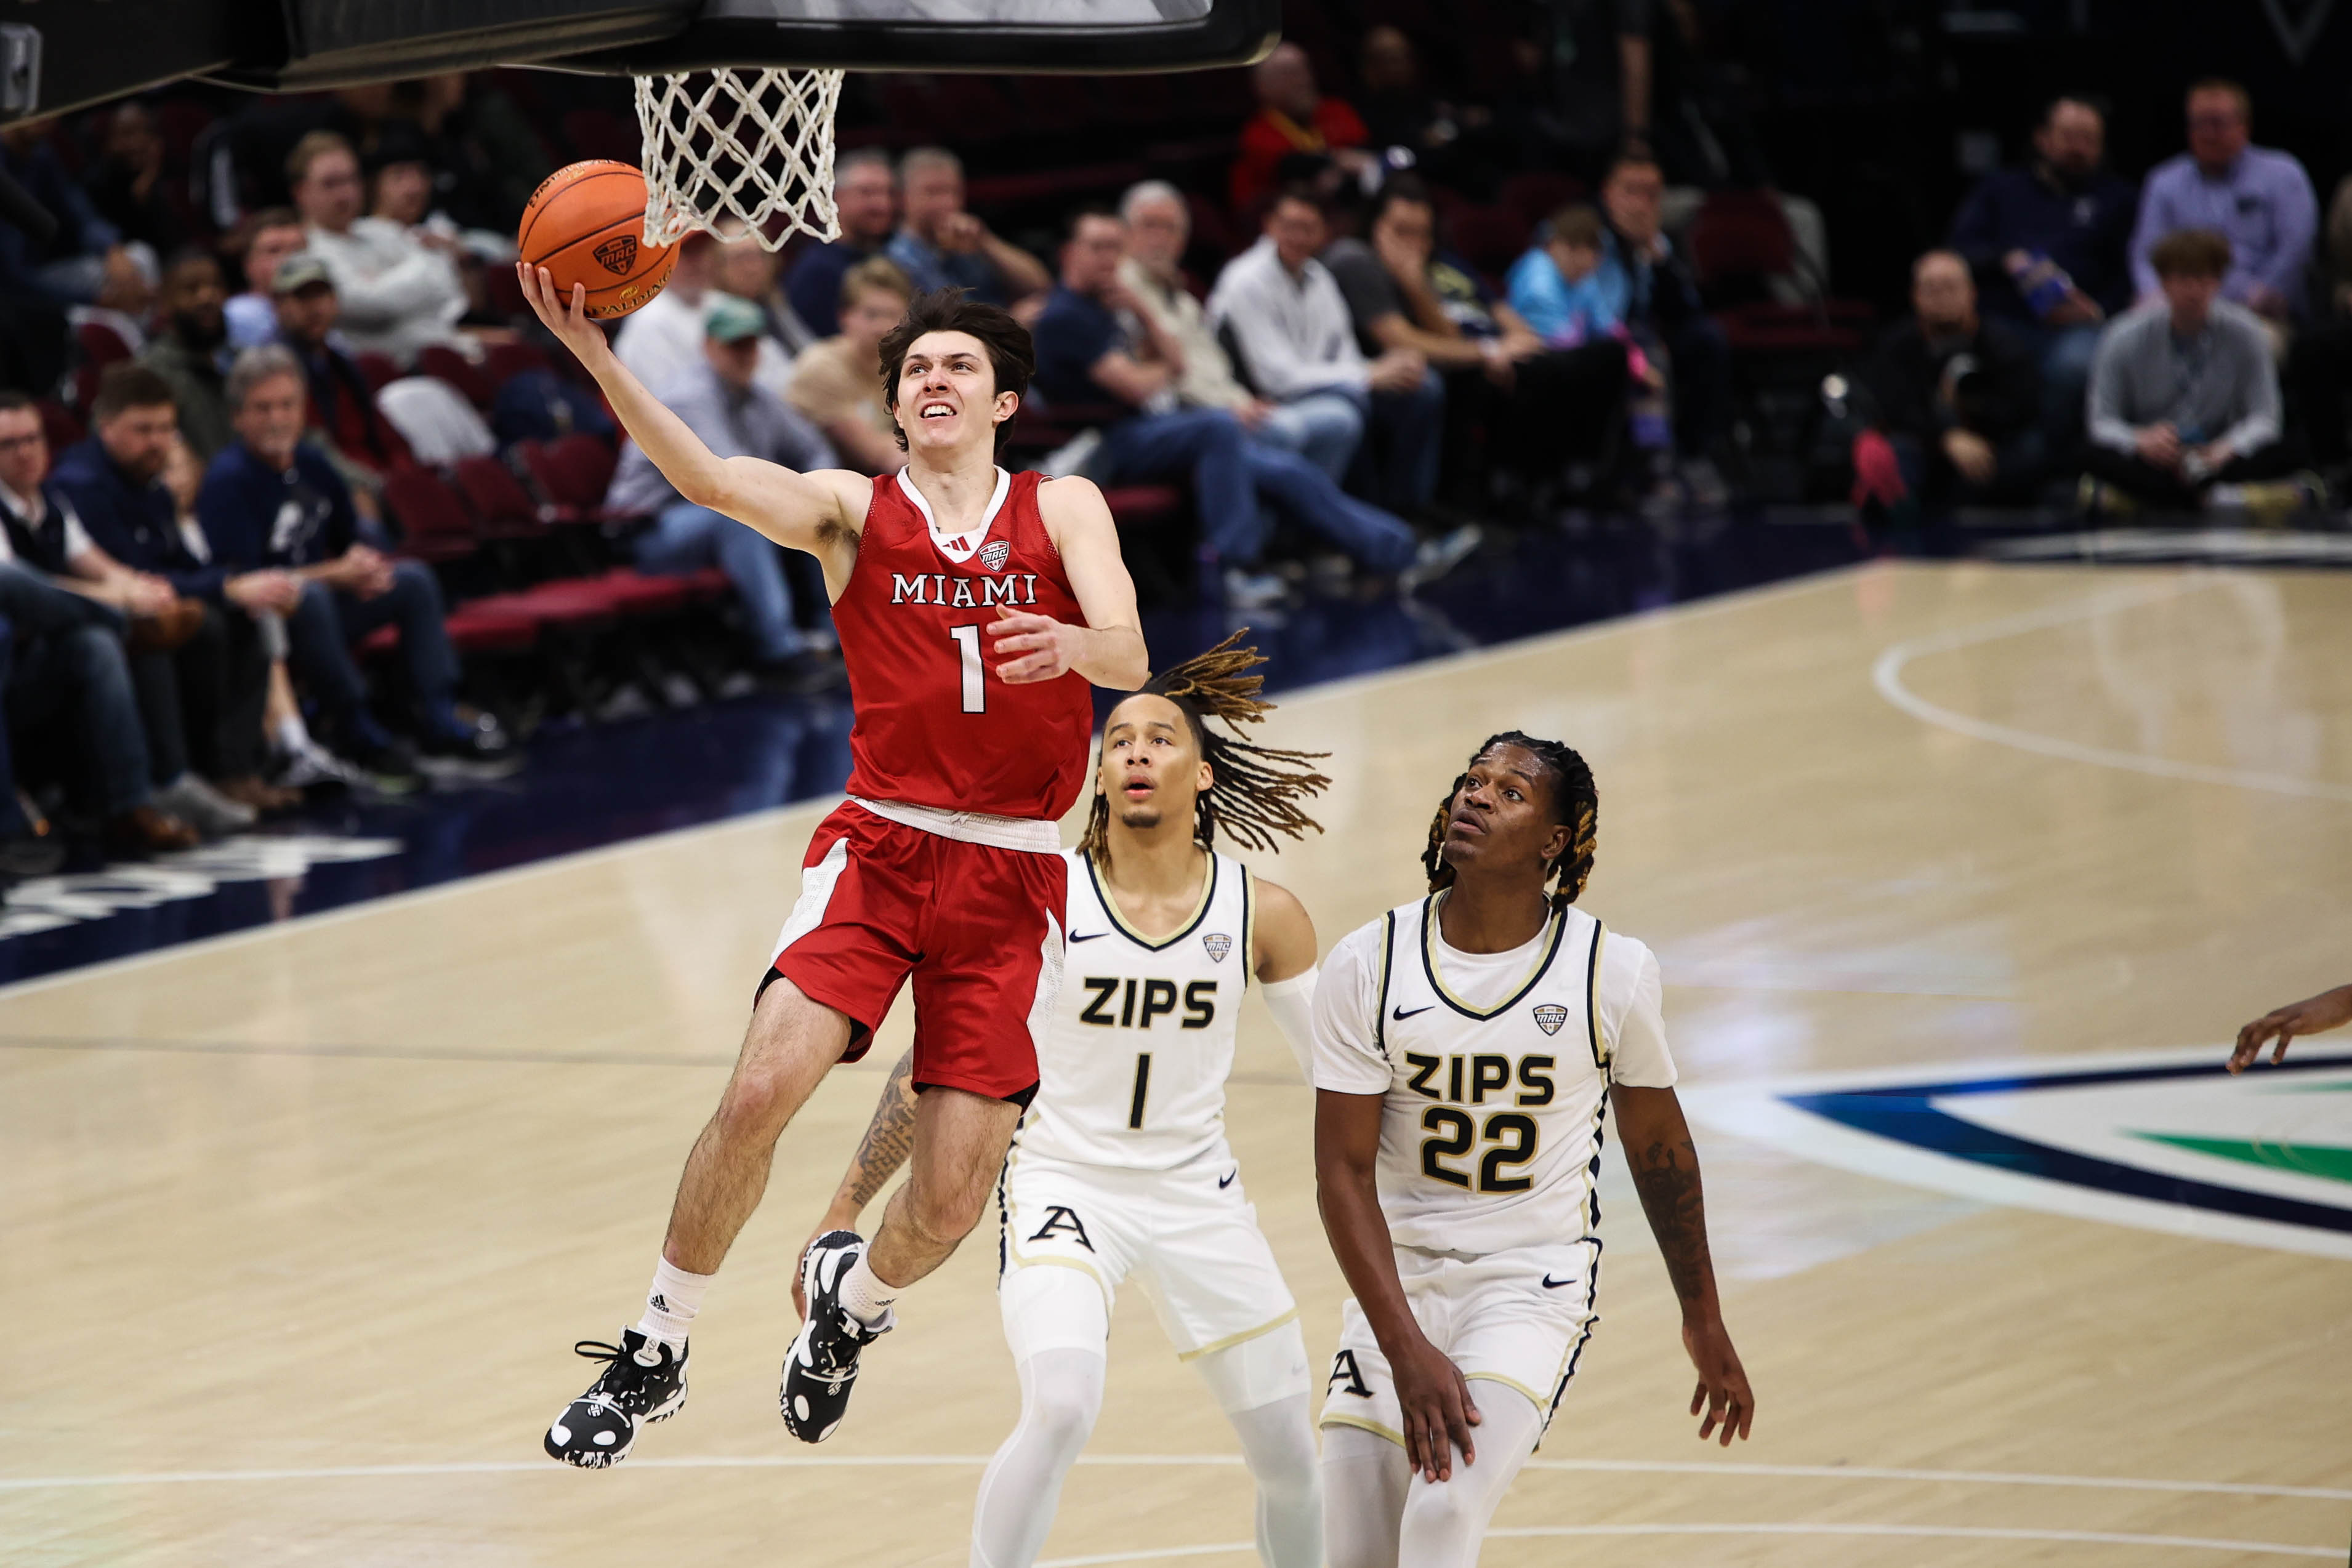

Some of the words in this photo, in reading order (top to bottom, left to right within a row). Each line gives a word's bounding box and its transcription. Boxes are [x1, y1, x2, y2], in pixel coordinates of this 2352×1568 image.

[601, 244, 637, 267] MAC
[981, 548, 1008, 563] MAC
[890, 573, 1038, 608] MIAMI
[949, 623, 986, 714] 1
[1206, 941, 1231, 952] MAC
[1079, 976, 1218, 1030] ZIPS
[1536, 1013, 1565, 1023] MAC
[1404, 1050, 1557, 1108] ZIPS
[1419, 1104, 1540, 1195] 22
[1027, 1205, 1095, 1253] A
[1326, 1349, 1375, 1398] A
